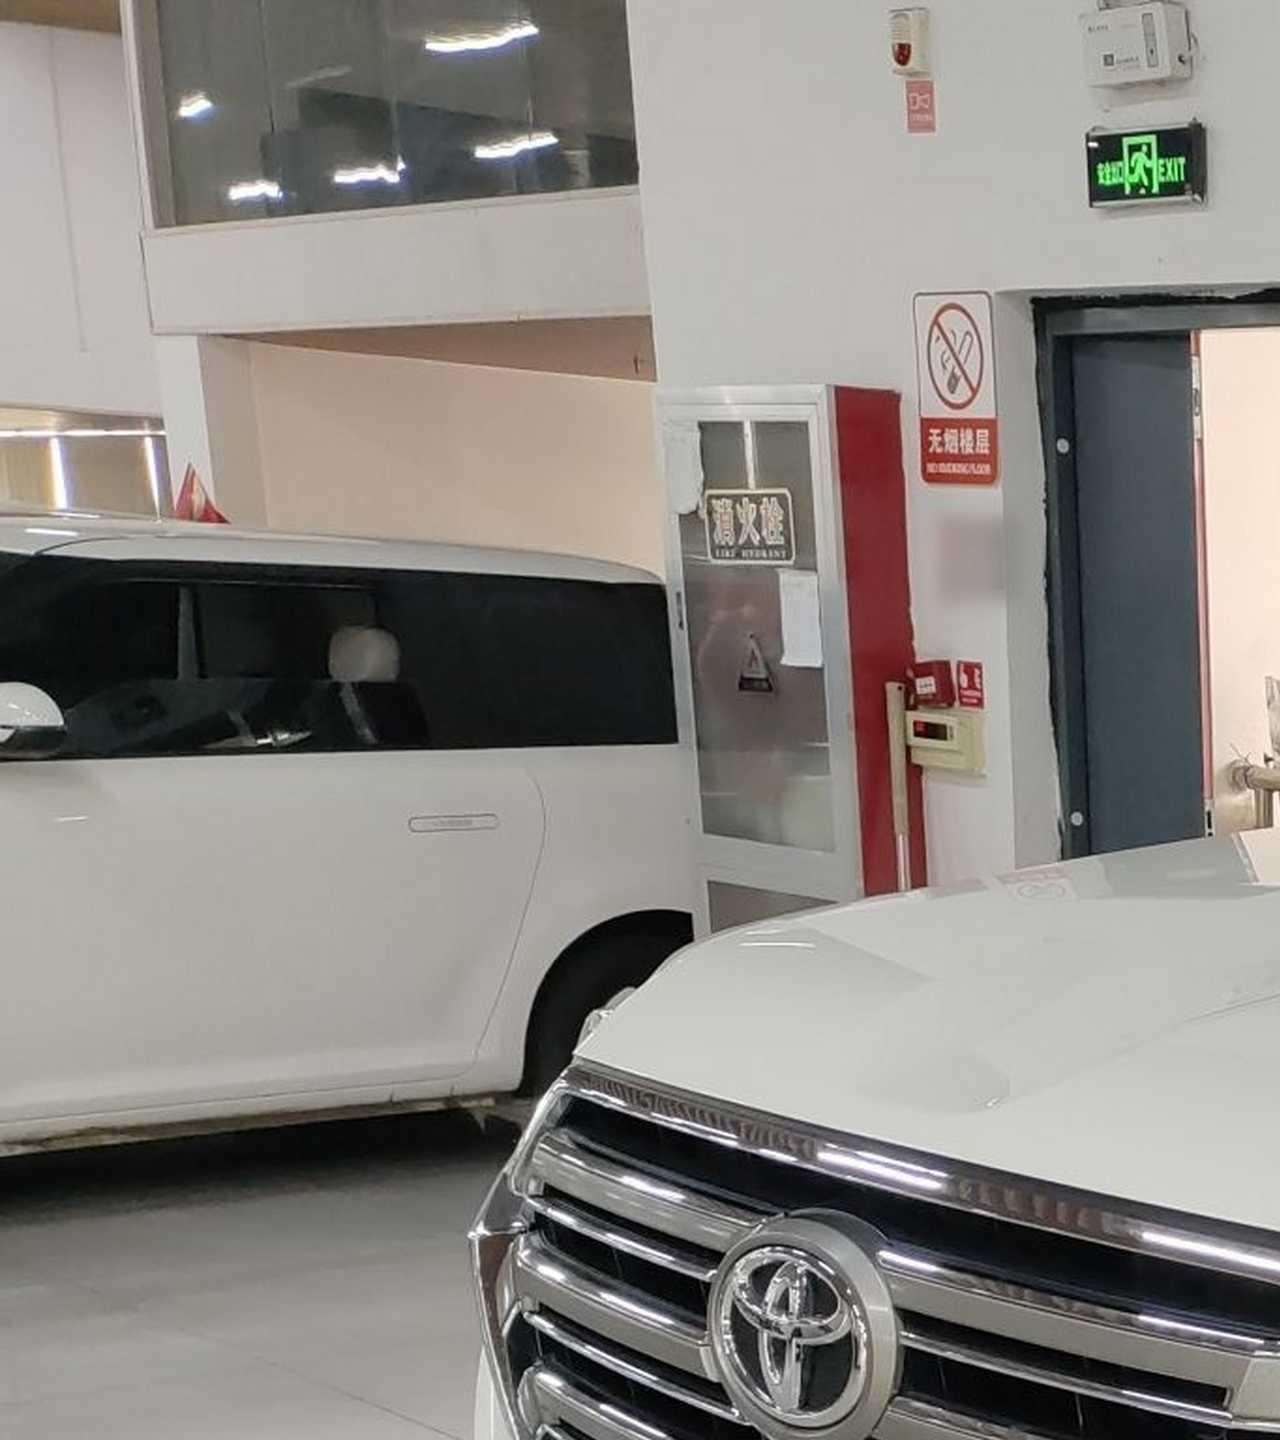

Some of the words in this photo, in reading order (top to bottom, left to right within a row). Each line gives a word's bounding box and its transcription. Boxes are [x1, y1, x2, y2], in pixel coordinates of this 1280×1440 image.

[1158, 157, 1186, 182] EXIT
[928, 428, 990, 454] 无烟楼层
[712, 497, 785, 546] 消火栓
